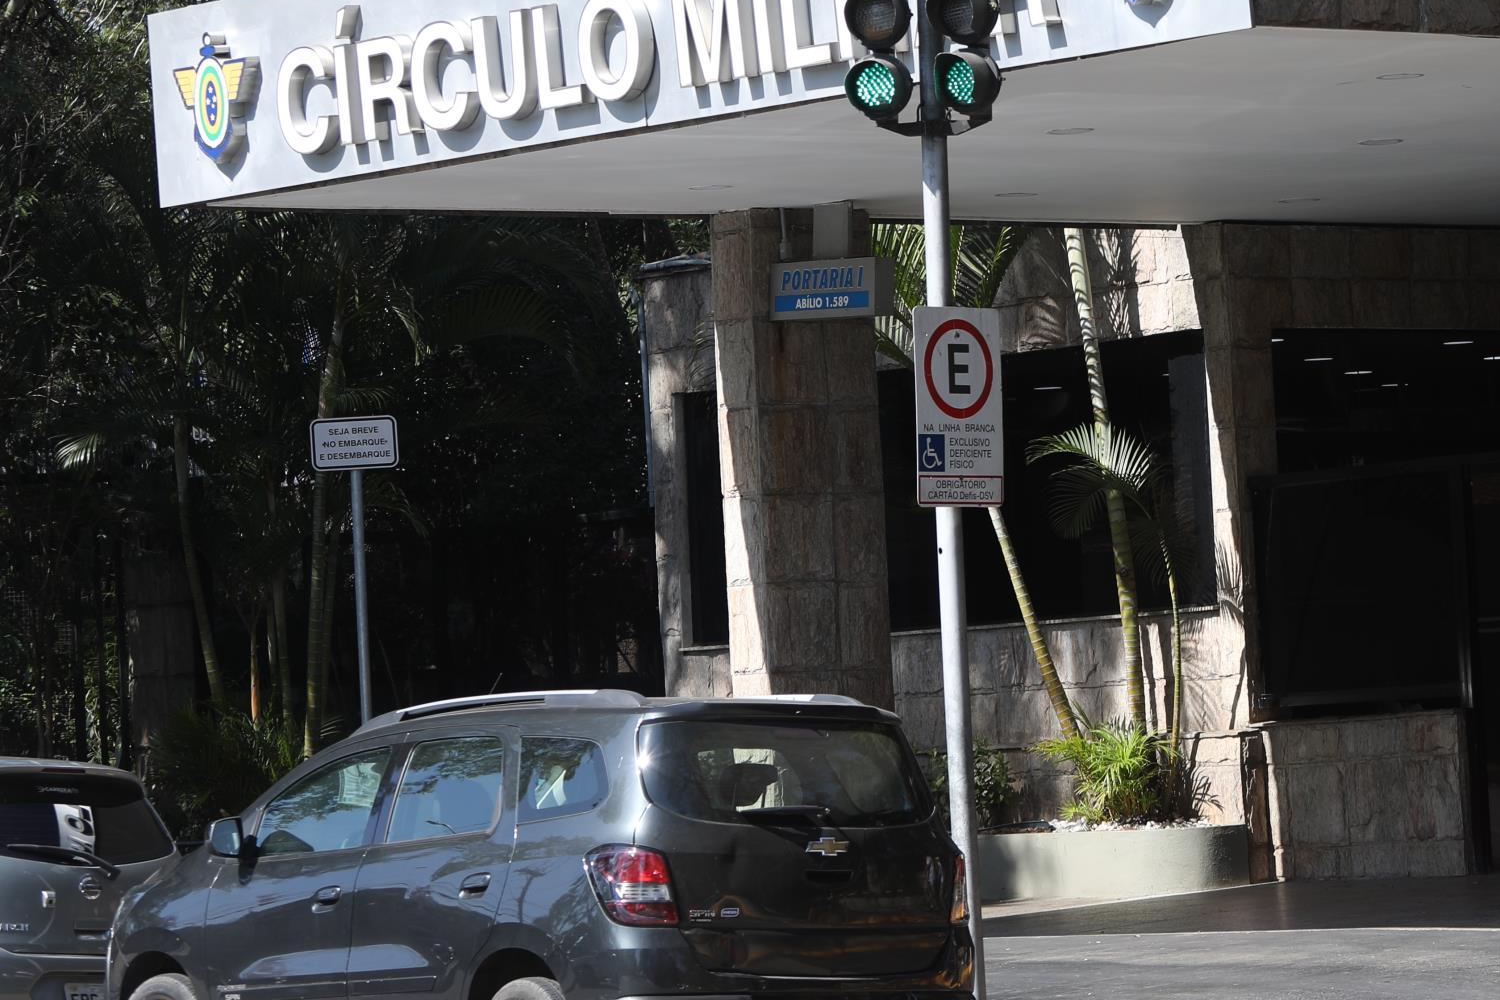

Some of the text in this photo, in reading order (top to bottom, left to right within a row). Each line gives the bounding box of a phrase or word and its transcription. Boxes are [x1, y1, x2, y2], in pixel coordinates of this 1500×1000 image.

[782, 266, 854, 292] PORTARIA
[795, 295, 849, 310] ABÍLIO 1.589
[948, 344, 971, 394] E
[328, 426, 379, 436] SEJA BREVE
[923, 423, 996, 433] NA LINHA BRANCA
[323, 438, 386, 448] NO EMBARQUE
[949, 437, 990, 447] EXCLUSIVO
[319, 450, 391, 461] E DESEMBARQUE
[949, 448, 992, 458] DEFICIENTE
[949, 459, 974, 469] FÍSICO
[935, 479, 987, 489] OBRIGATÓRIO
[928, 489, 958, 500] CARTÃO
